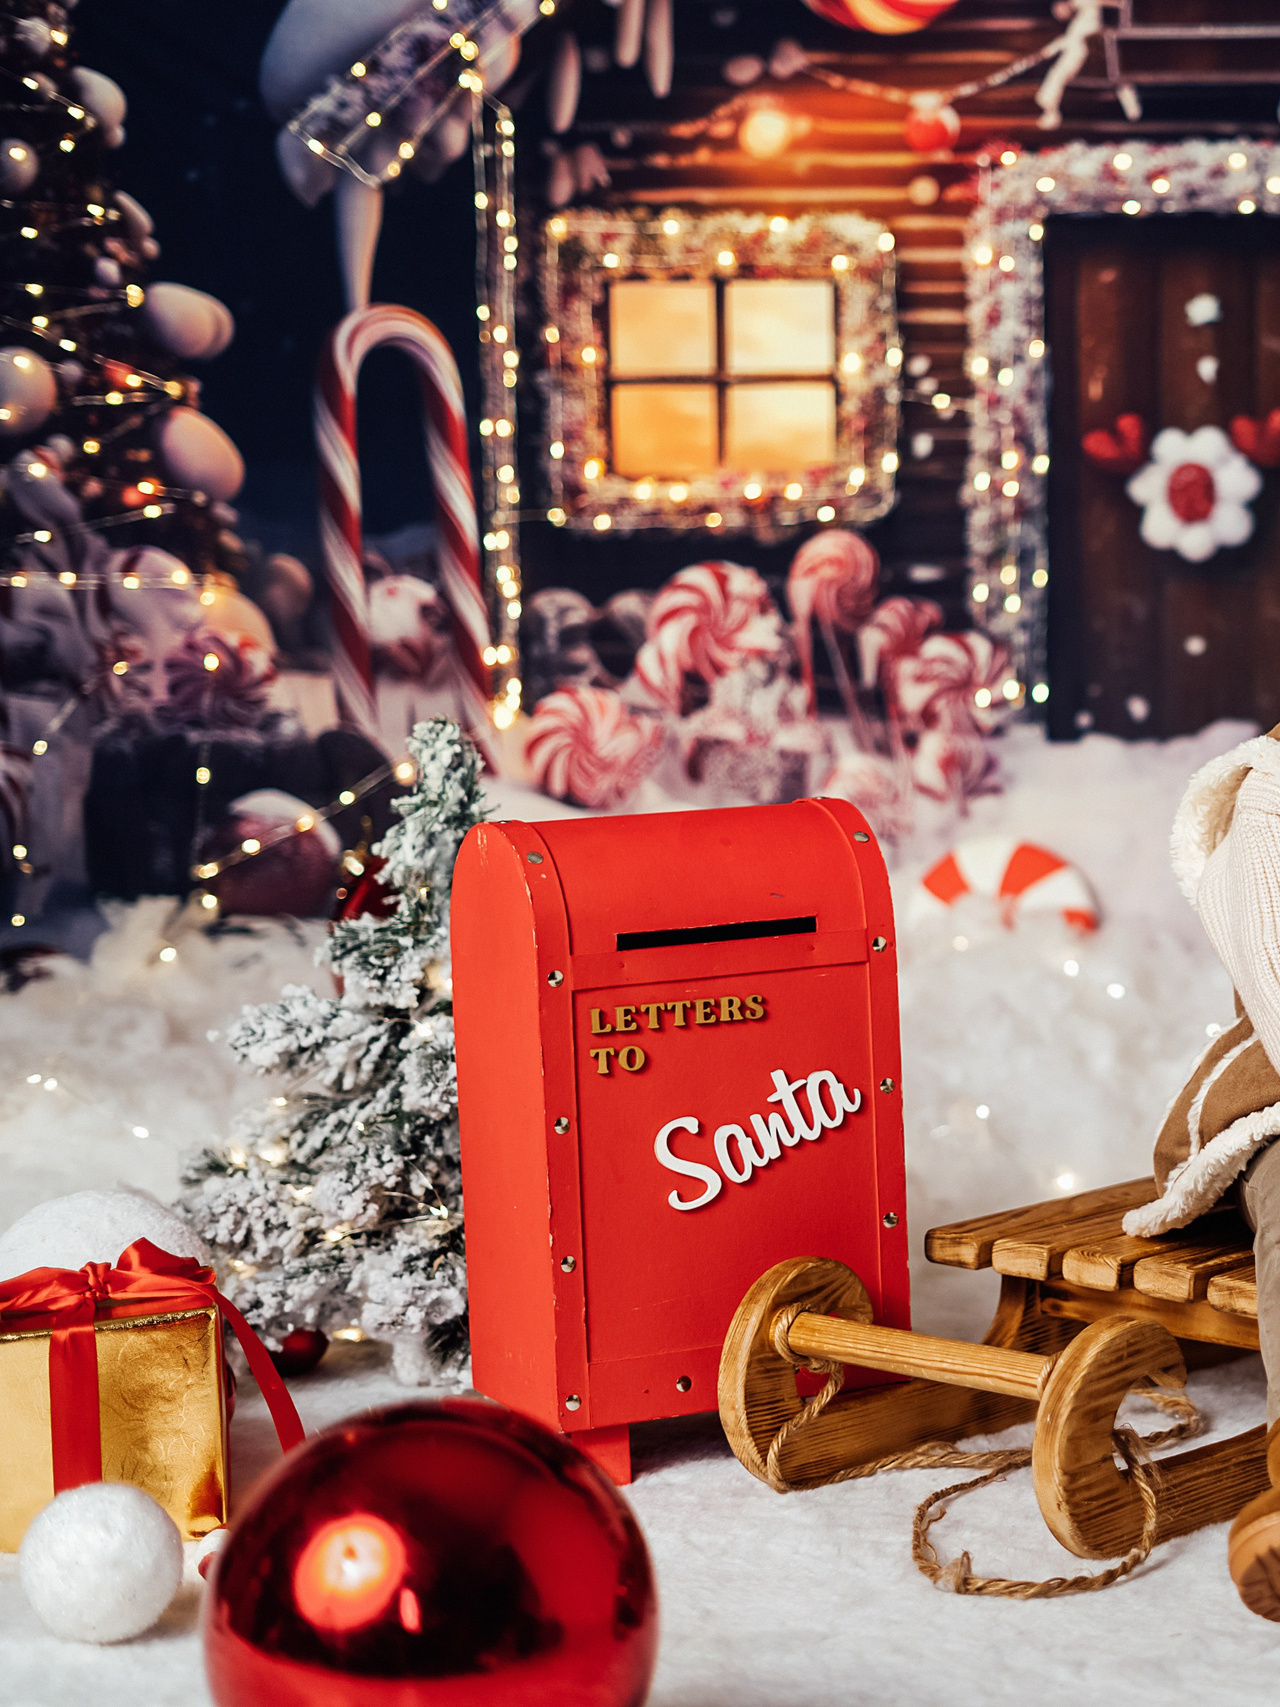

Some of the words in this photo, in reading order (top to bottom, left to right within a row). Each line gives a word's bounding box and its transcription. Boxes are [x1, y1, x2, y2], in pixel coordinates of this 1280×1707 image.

[588, 994, 765, 1034] LETTERS
[589, 1045, 646, 1074] TO
[654, 1069, 862, 1211] Santa
